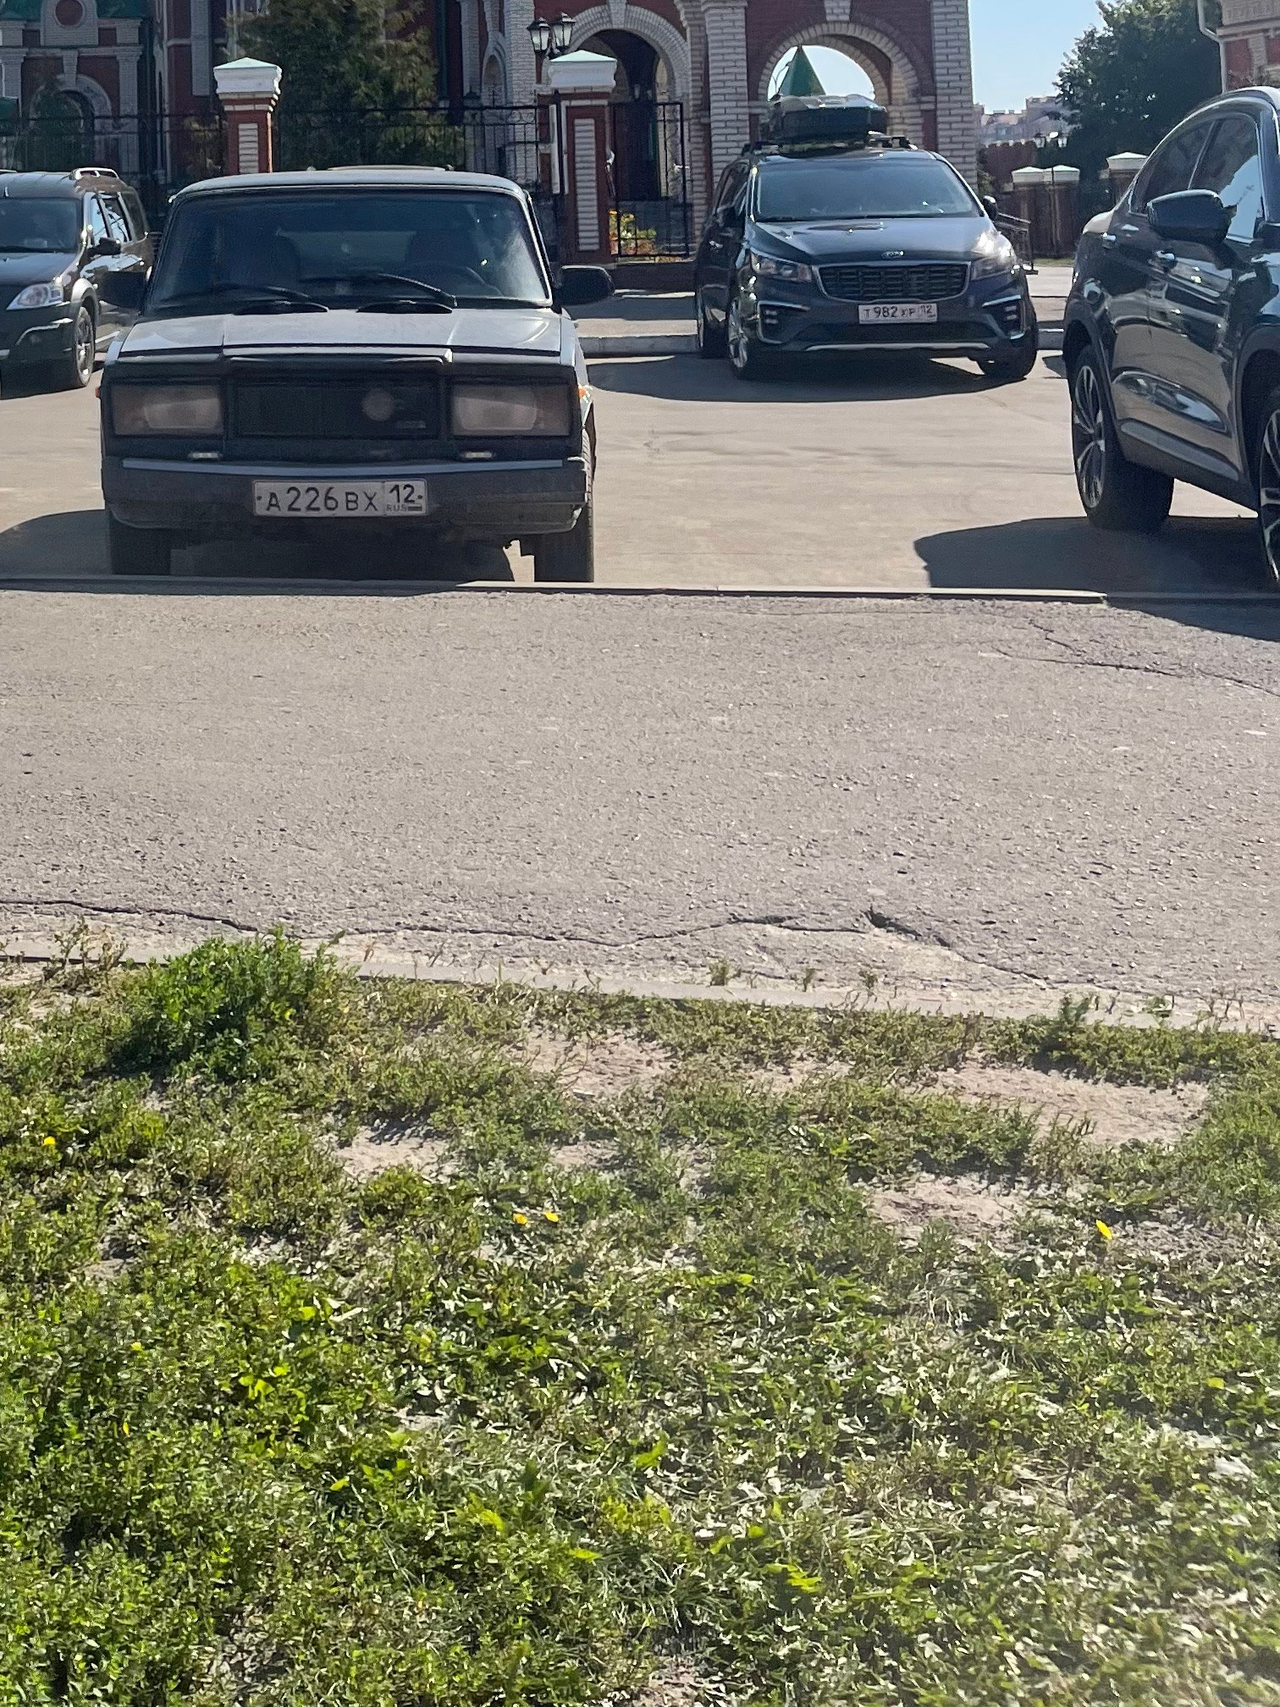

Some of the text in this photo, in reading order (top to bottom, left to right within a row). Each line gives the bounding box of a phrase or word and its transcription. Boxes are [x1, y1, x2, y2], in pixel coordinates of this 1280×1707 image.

[266, 483, 416, 512] А226ВХ 12
[386, 504, 407, 512] RUS
